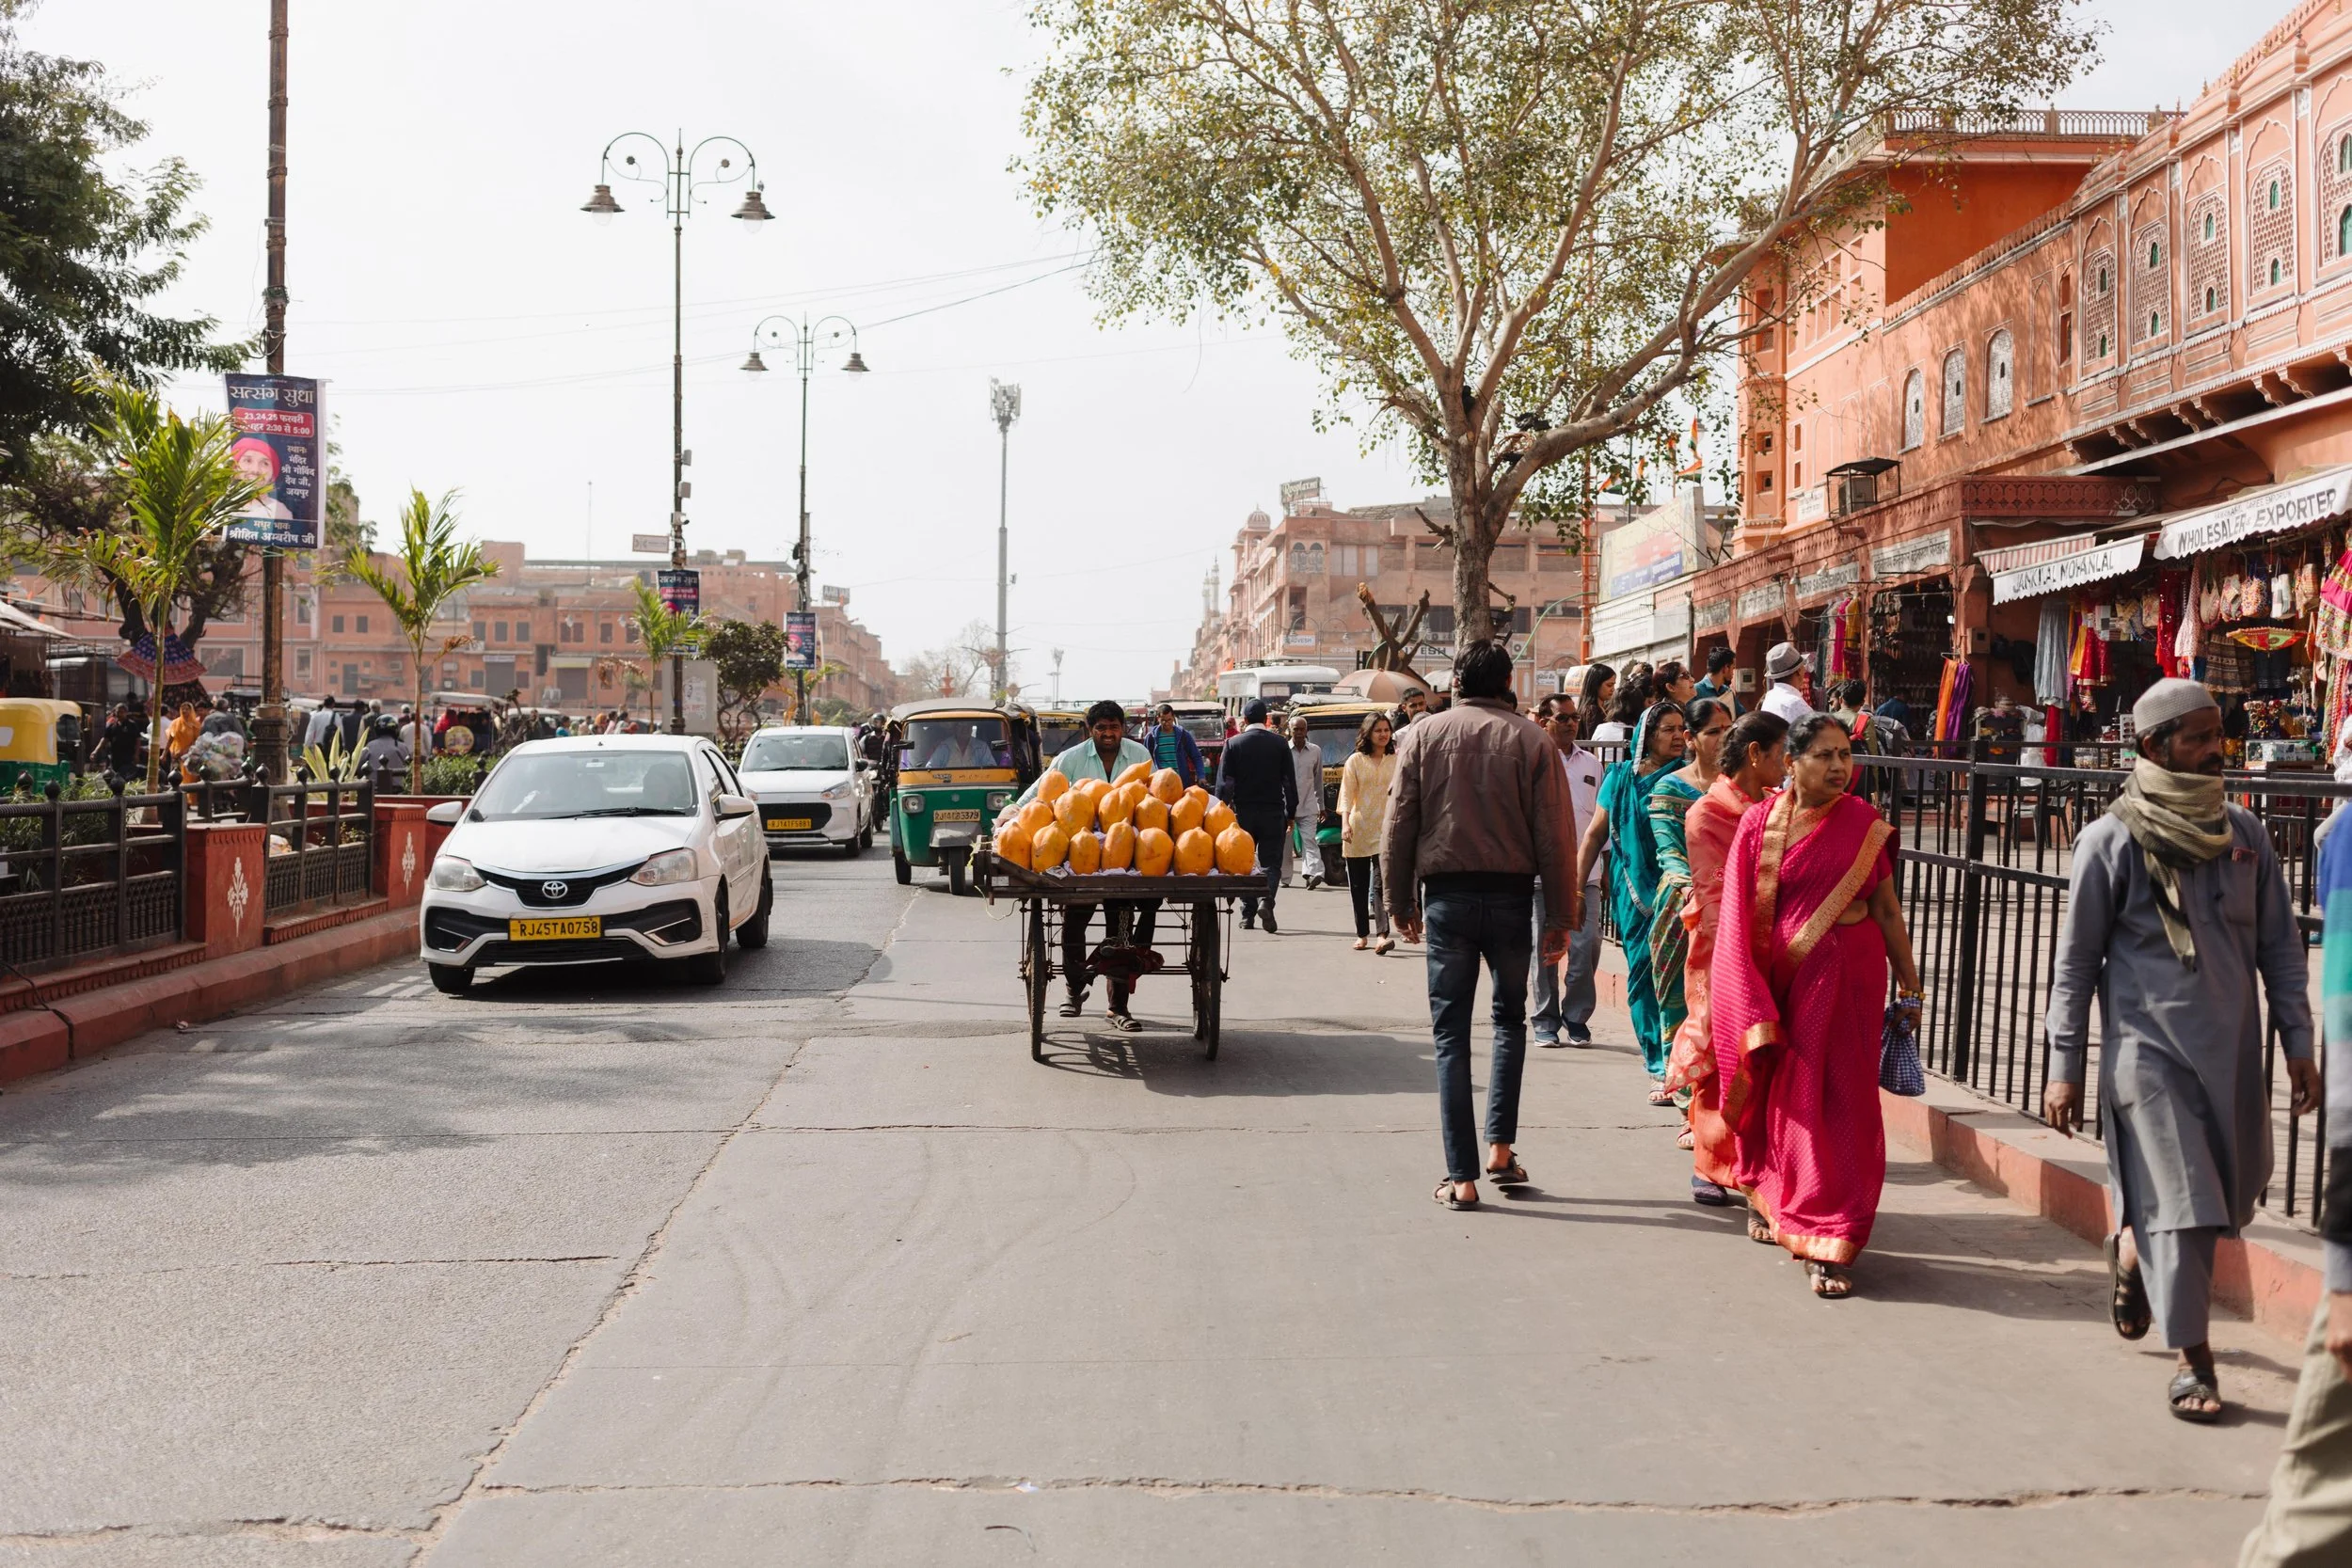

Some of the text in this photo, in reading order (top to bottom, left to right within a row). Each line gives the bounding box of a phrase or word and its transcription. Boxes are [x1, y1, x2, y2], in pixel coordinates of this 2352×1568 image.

[229, 384, 315, 407] सत्संग सुधा
[278, 413, 304, 423] फरवरी
[265, 423, 282, 432] 2:30
[283, 423, 291, 433] से
[286, 487, 309, 499] जयपुर
[2178, 513, 2247, 553] WHOLESALER
[2252, 488, 2337, 528] EXPORTER
[301, 532, 315, 545] जी
[2059, 550, 2114, 581] MOHANLAL
[519, 921, 598, 938] RJ45TA0758
